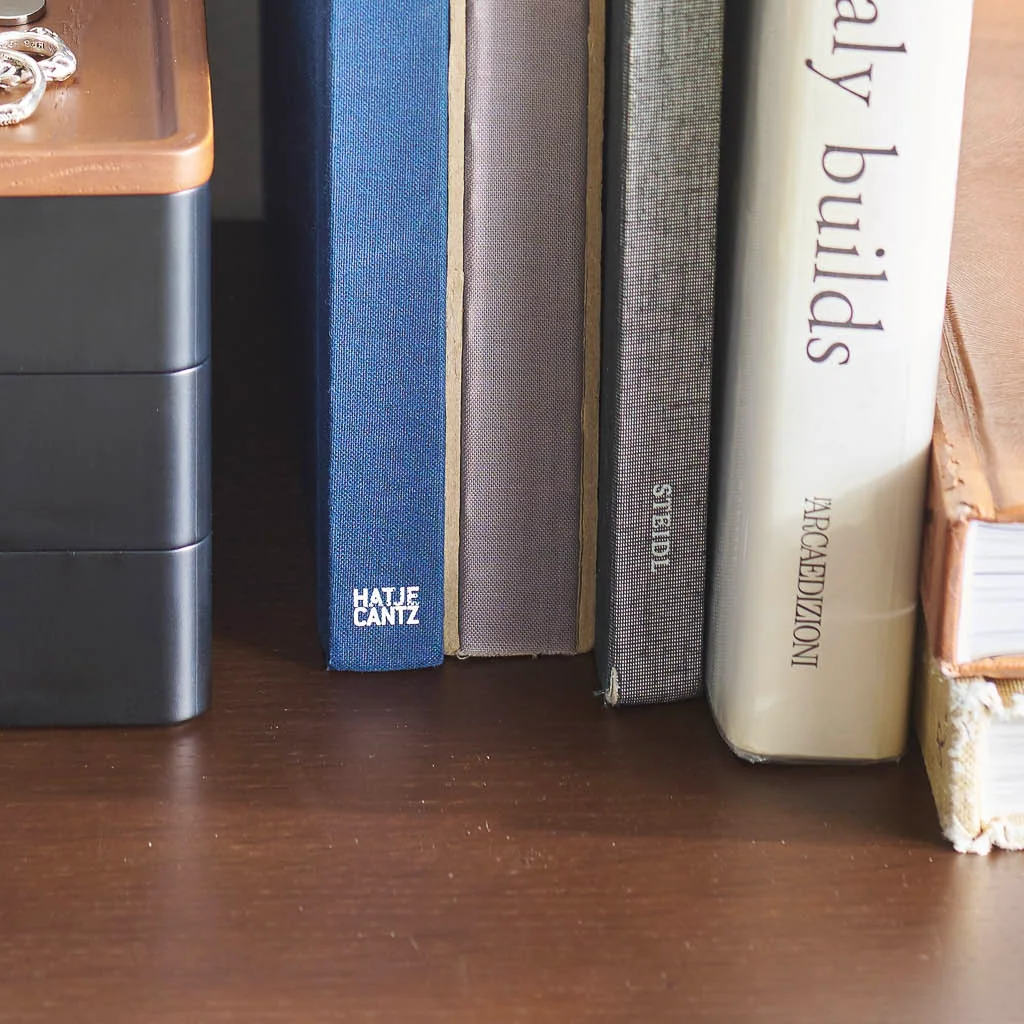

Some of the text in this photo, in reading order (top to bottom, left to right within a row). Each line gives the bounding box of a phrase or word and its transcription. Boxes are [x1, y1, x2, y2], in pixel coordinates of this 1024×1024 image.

[805, 143, 900, 367] builds
[651, 483, 673, 573] STEIDL
[353, 587, 420, 608] HATJE
[353, 606, 420, 627] CANTZ
